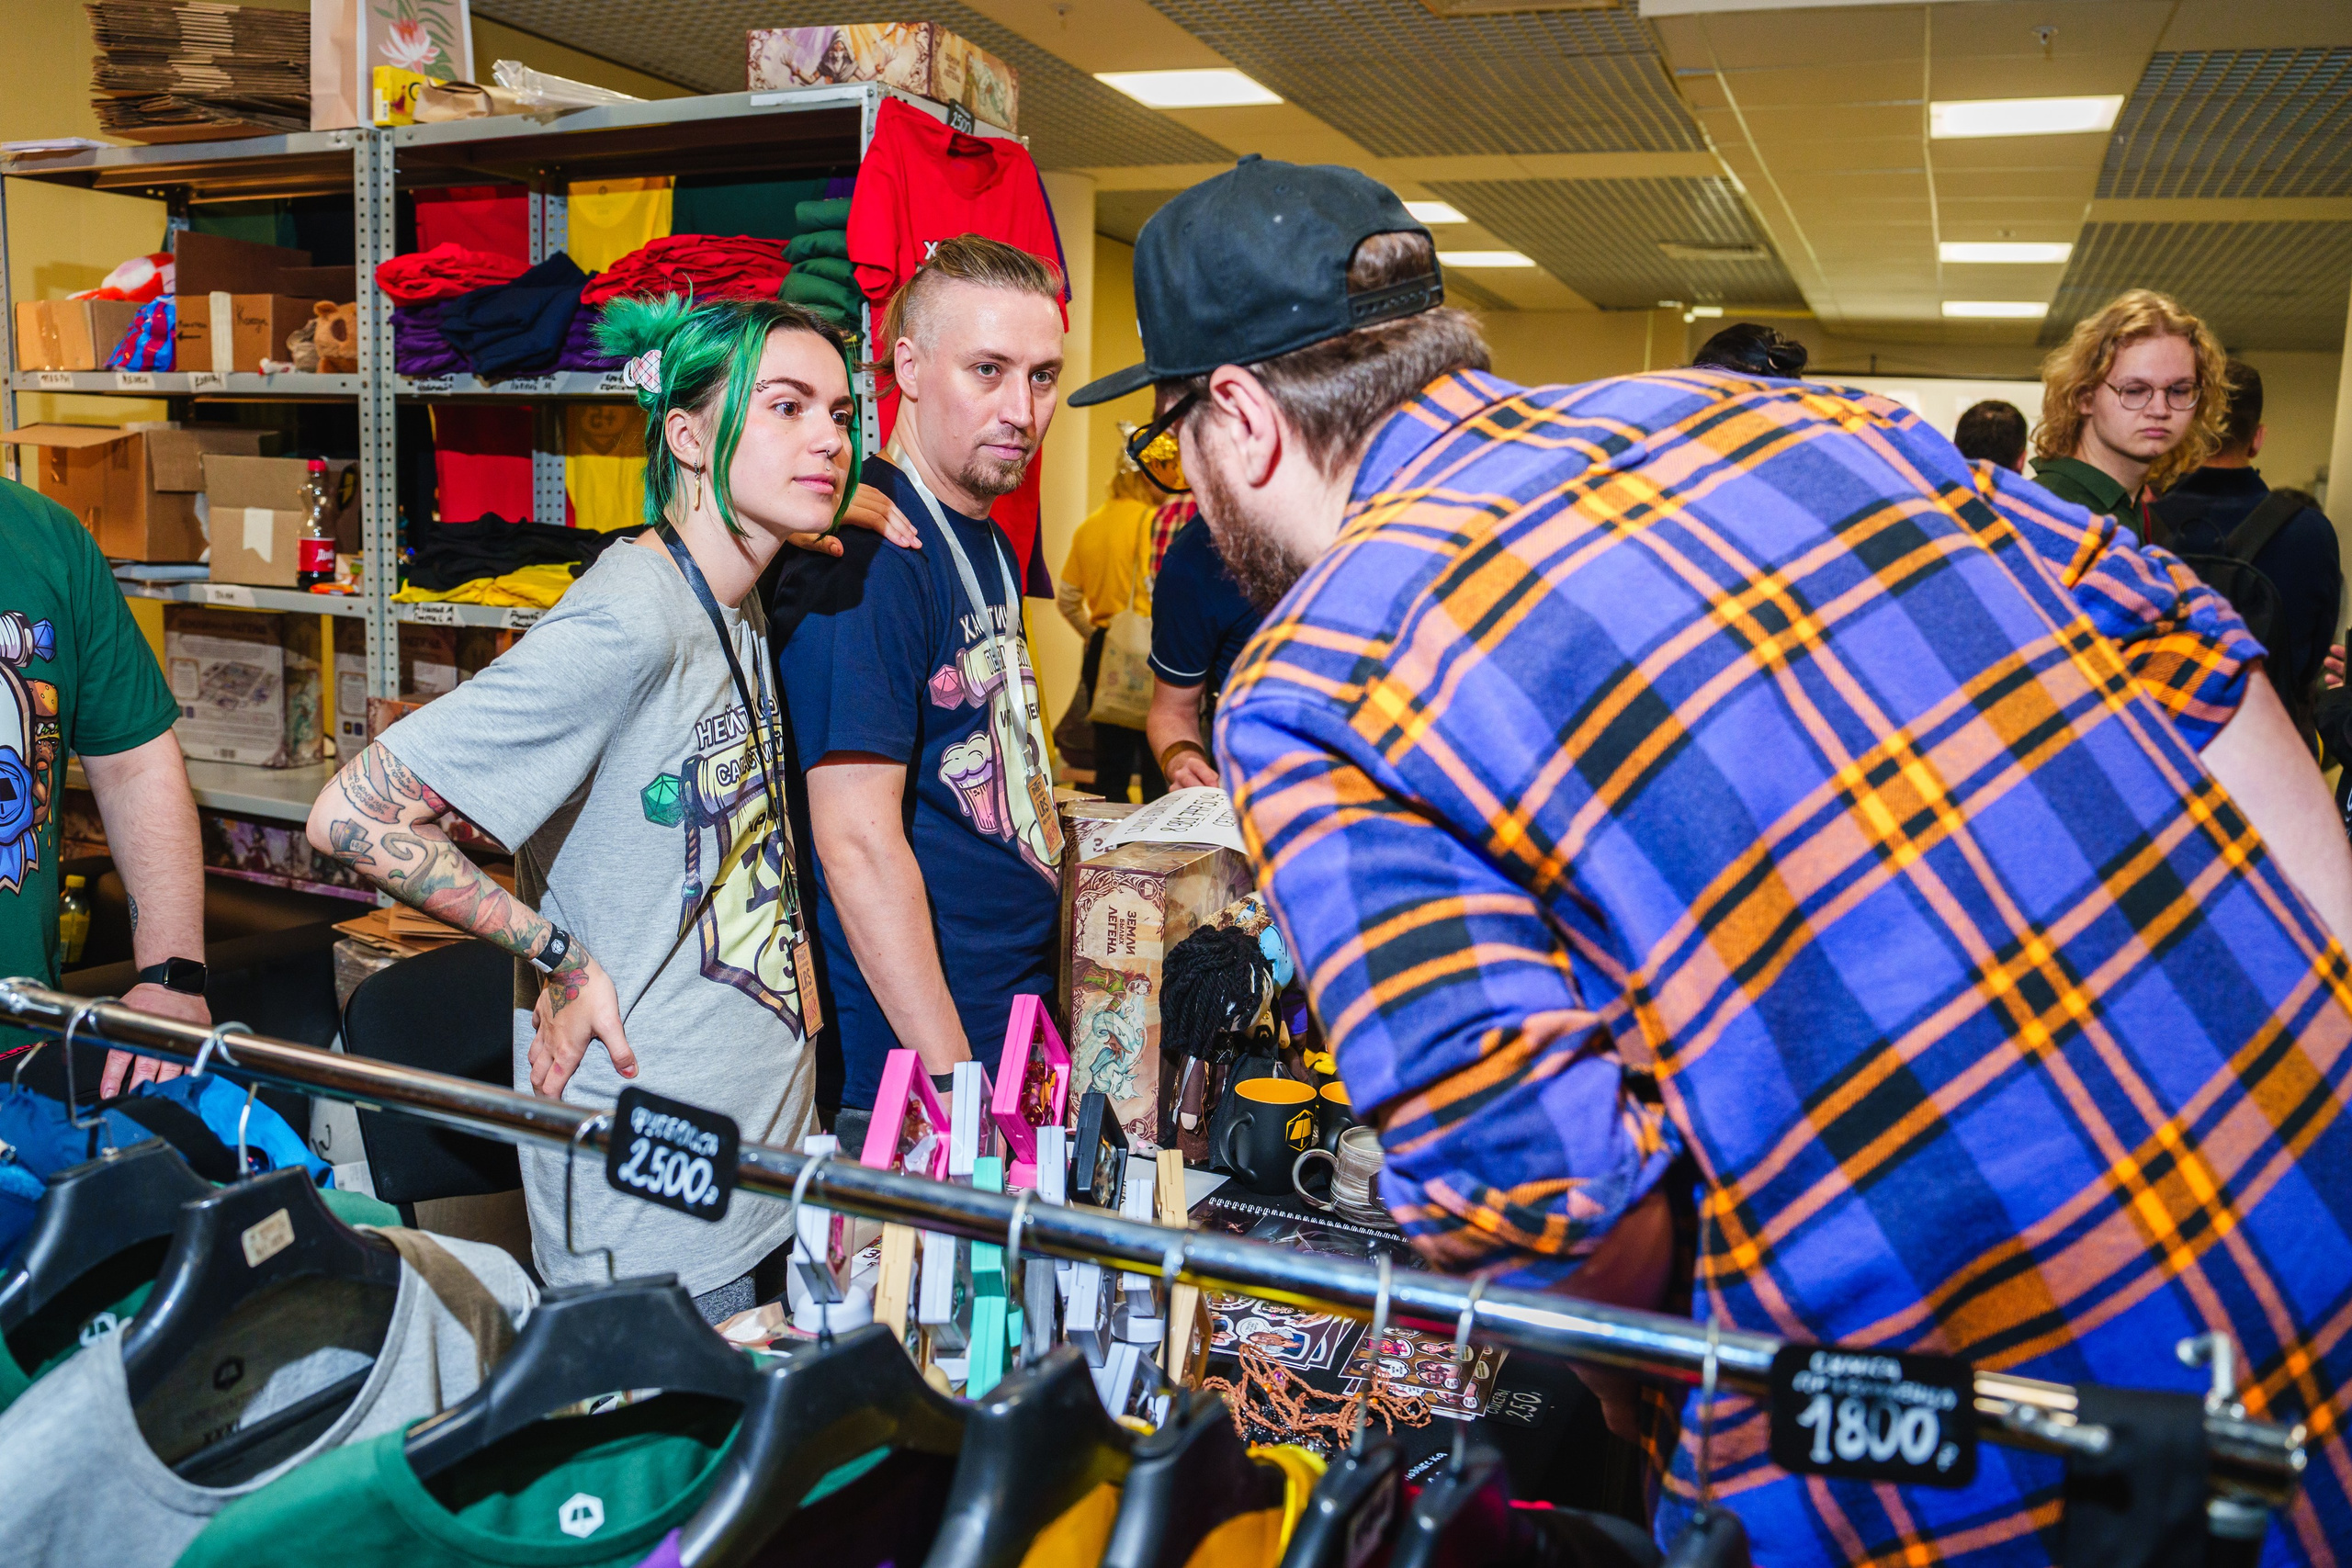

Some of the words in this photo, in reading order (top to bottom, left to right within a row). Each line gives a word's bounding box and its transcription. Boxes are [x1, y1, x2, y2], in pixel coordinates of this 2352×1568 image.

[1038, 798, 1050, 818] LRS
[1106, 905, 1118, 956] ЛЕГЕНД
[1125, 910, 1137, 956] ЗЕМЛИ
[799, 966, 812, 990] LRS
